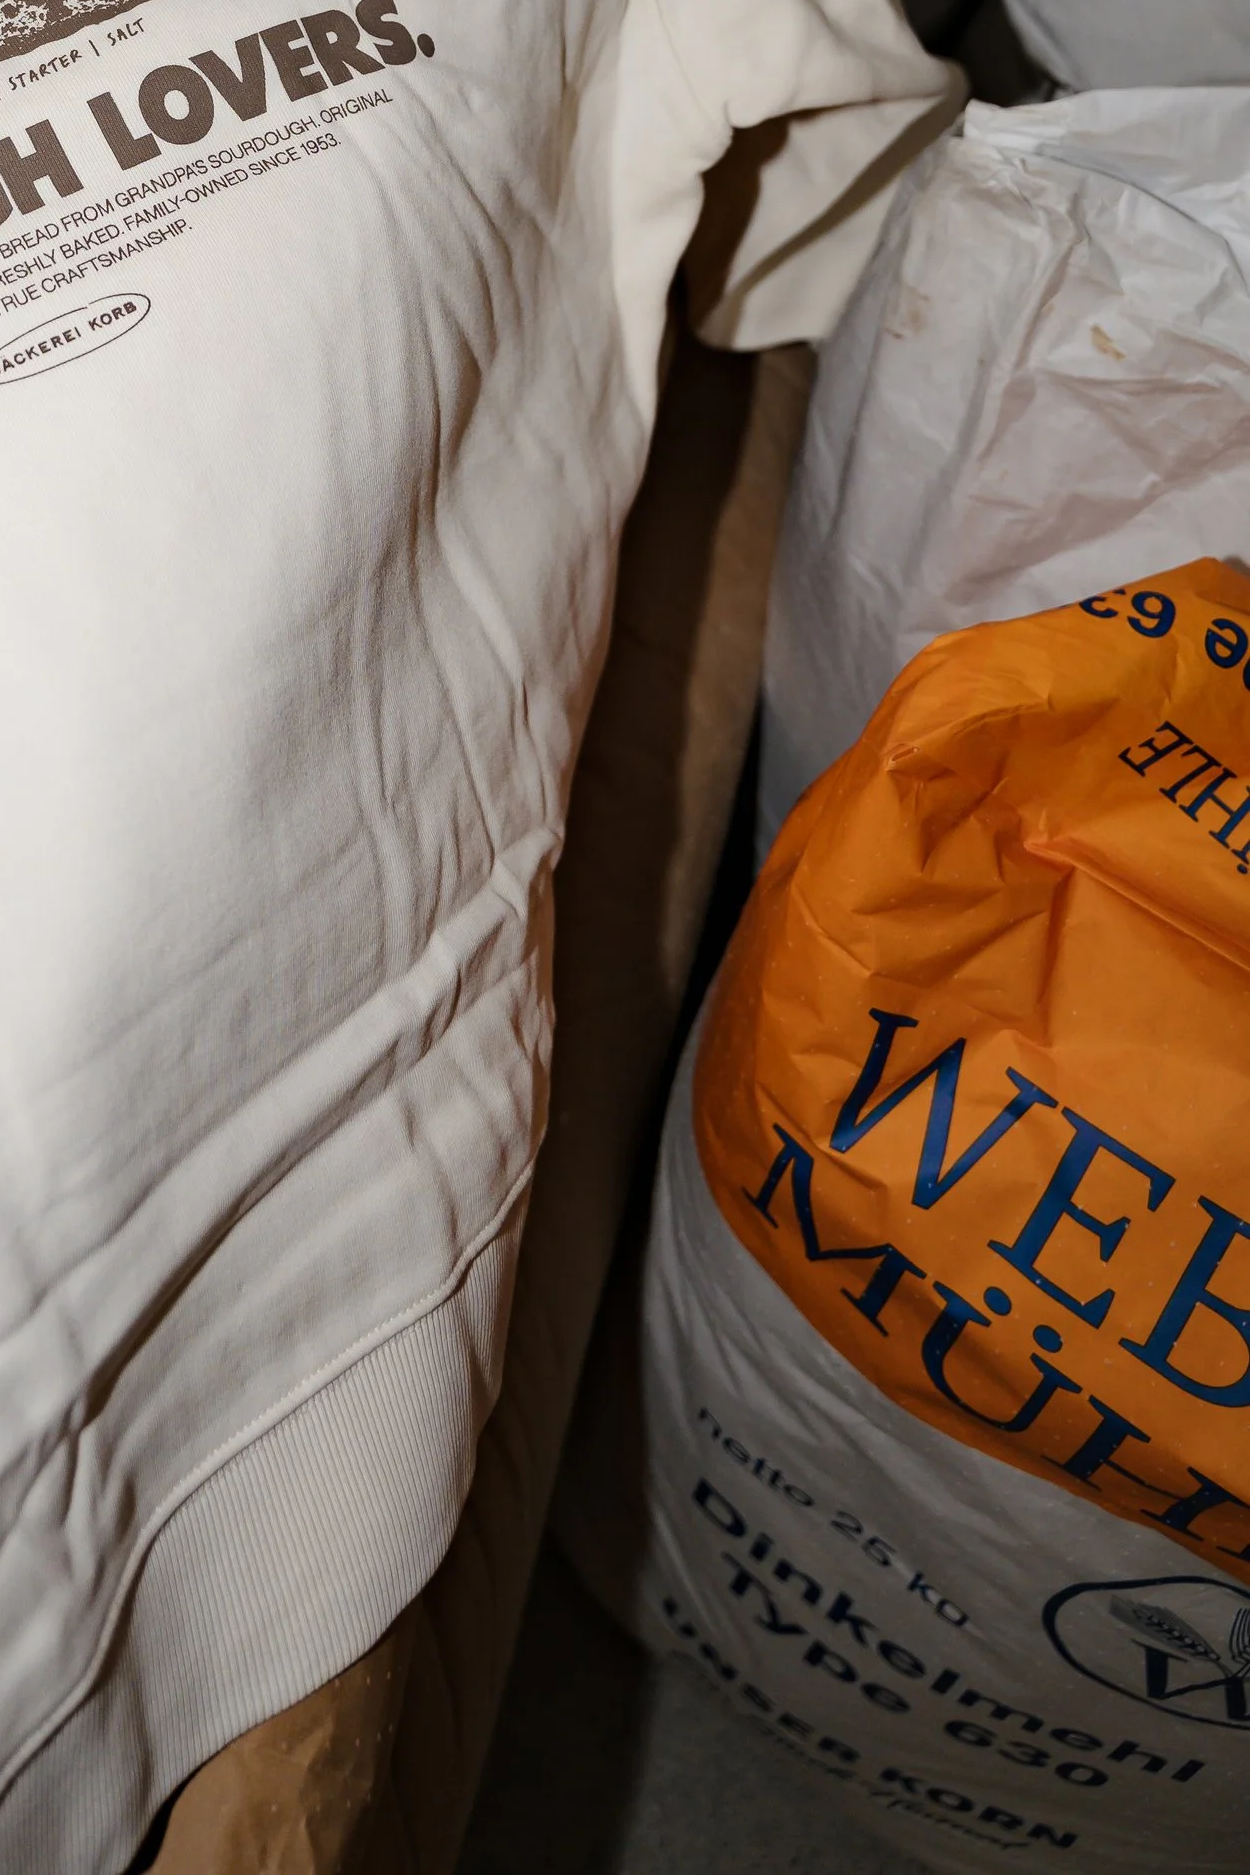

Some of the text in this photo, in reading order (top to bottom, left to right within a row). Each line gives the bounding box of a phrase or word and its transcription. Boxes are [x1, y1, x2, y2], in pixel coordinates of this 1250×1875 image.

[7, 48, 84, 92] STARTER
[105, 16, 146, 48] SALT
[59, 198, 115, 232] FROM
[114, 159, 209, 208] GRANDPA'S
[319, 88, 394, 124] ORIGINAL
[59, 223, 125, 260] BAKED.
[122, 168, 249, 232] FAMILY-OWNED
[247, 146, 302, 176] SINCE
[299, 132, 342, 156] 1953.
[41, 218, 193, 294] CRAFTSMANSHIP.
[87, 301, 138, 332] KORB
[1117, 720, 1250, 875] HLE
[742, 1122, 1250, 1562] MÜH
[699, 1407, 814, 1508] netto
[830, 1509, 897, 1569] 25
[692, 1478, 1208, 1784] Dinkelmehl
[721, 1551, 910, 1714] Type
[943, 1718, 1110, 1789] 630
[662, 1597, 861, 1764] UNSER
[880, 1767, 1080, 1850] KORN
